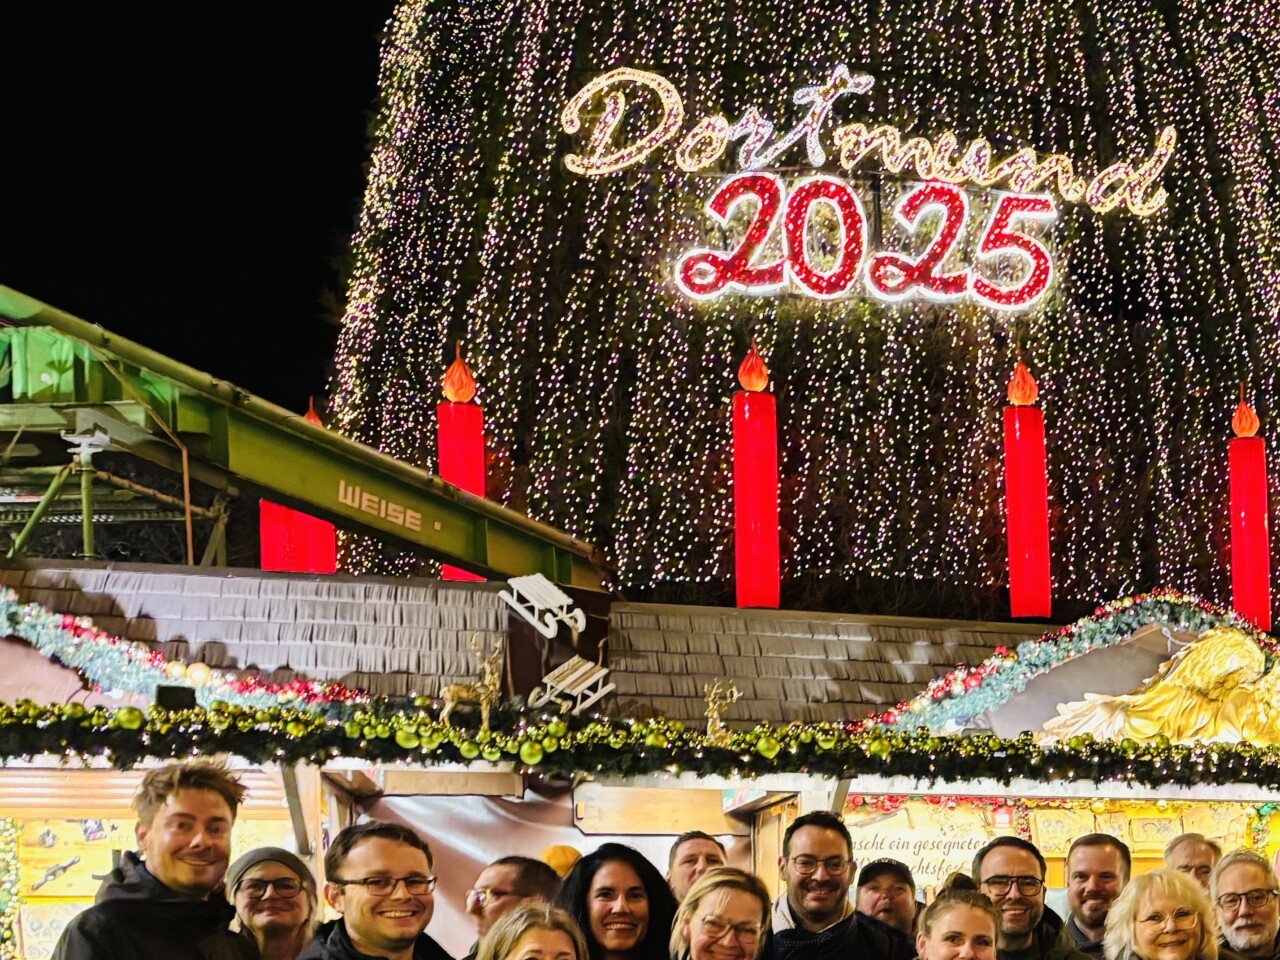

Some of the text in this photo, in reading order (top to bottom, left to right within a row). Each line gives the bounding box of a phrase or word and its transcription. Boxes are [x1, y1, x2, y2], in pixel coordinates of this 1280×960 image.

[561, 63, 1178, 216] Dortmund
[674, 171, 1057, 312] 2025
[338, 479, 422, 532] WEISE
[888, 837, 910, 851] ein
